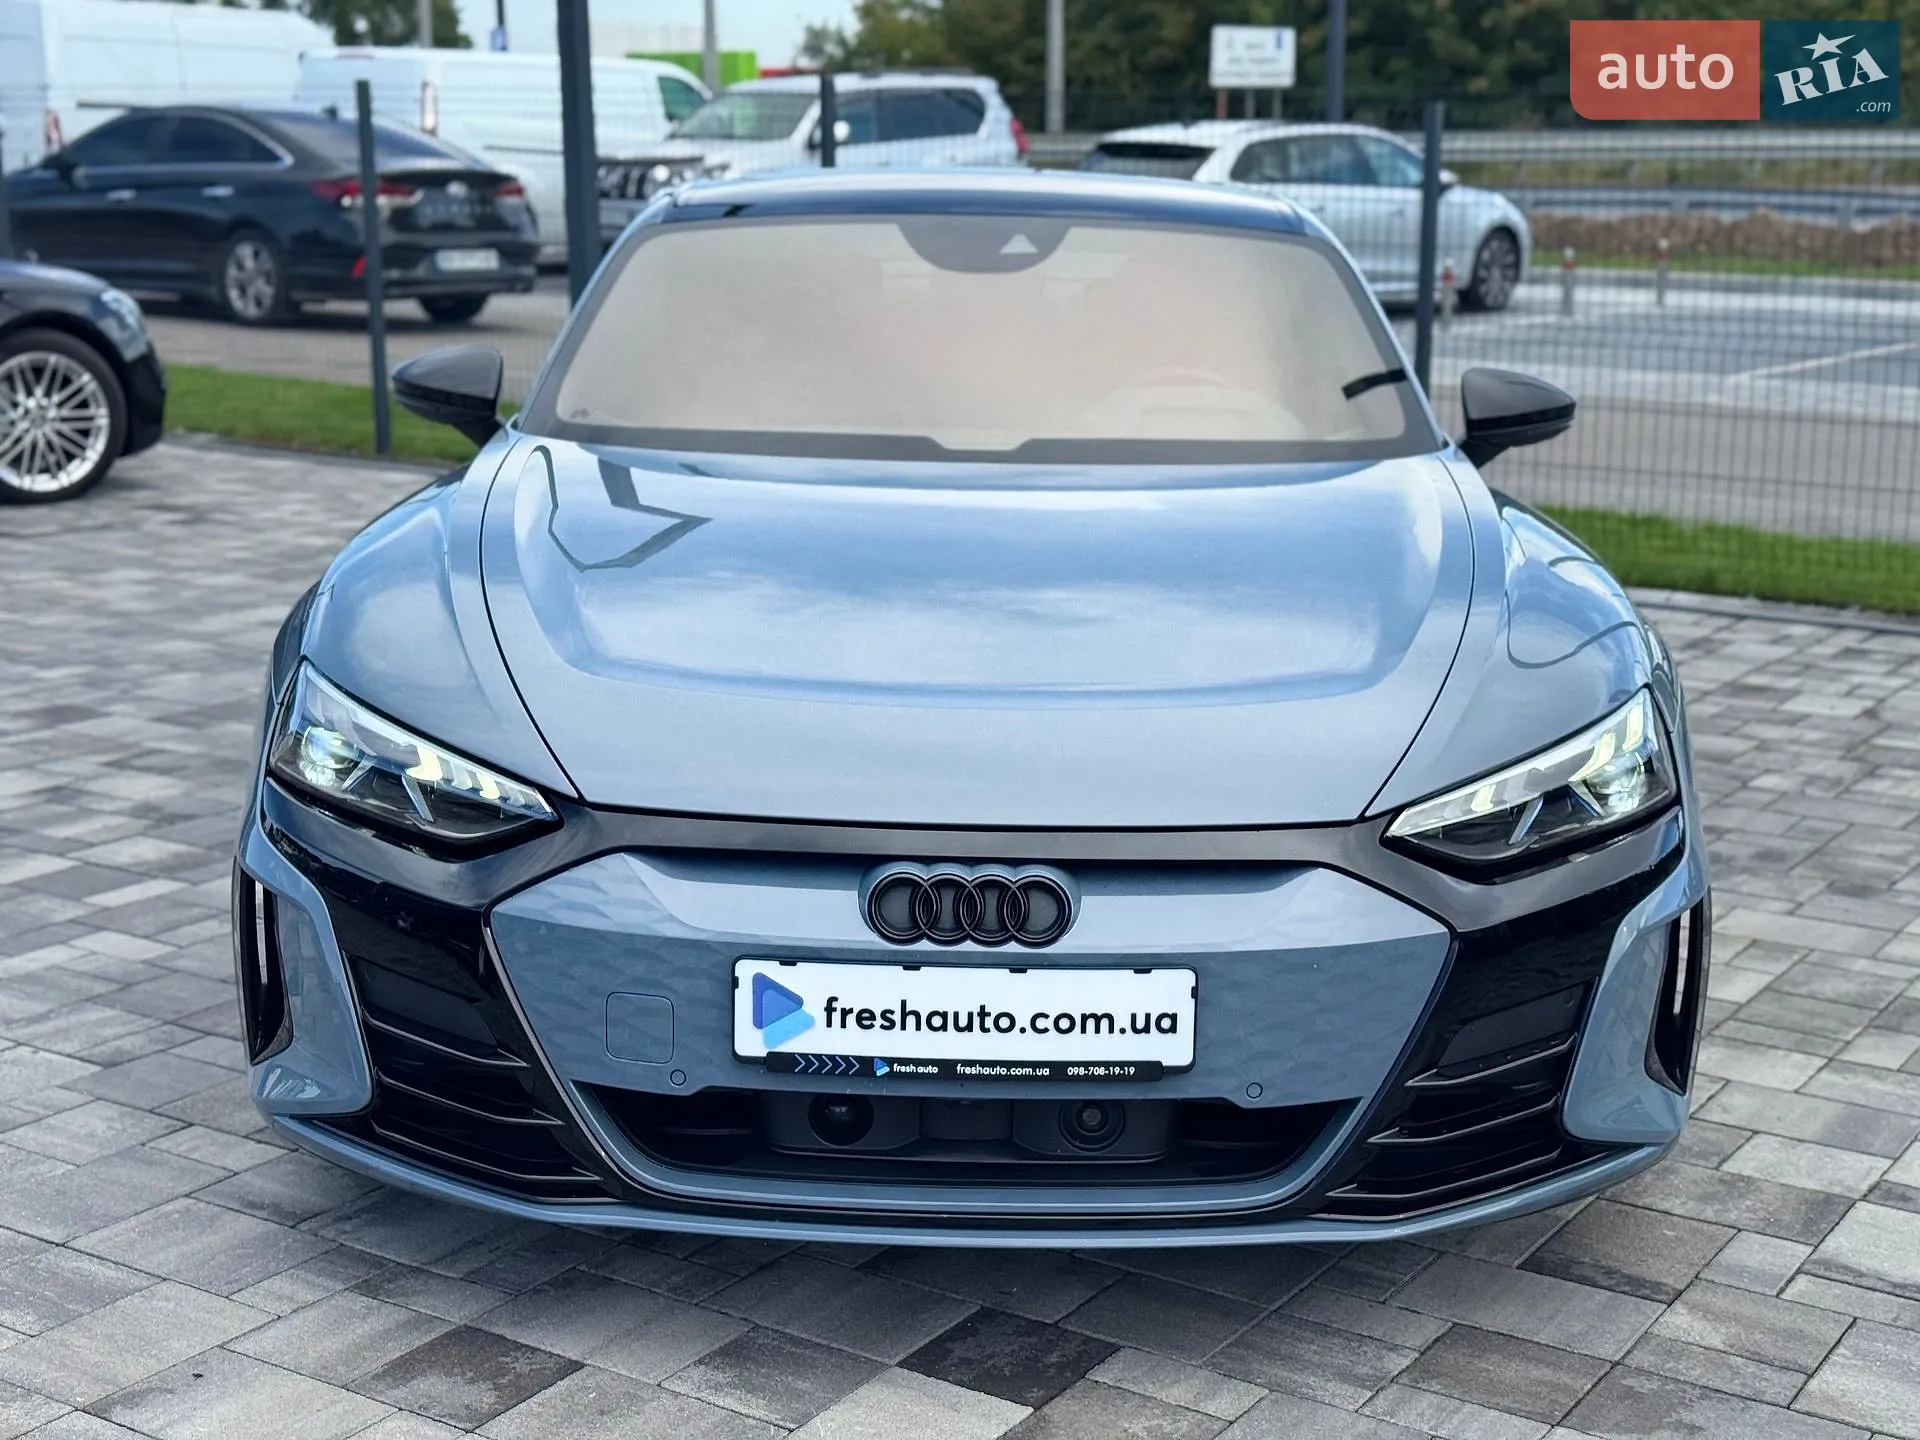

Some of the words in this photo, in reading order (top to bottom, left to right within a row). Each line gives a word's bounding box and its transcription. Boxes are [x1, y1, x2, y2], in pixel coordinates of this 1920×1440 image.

[824, 996, 1178, 1036] freshauto.com.ua
[956, 1063, 1050, 1076] freshauto.com.ua
[1067, 1066, 1135, 1076] 098-708-19-19
